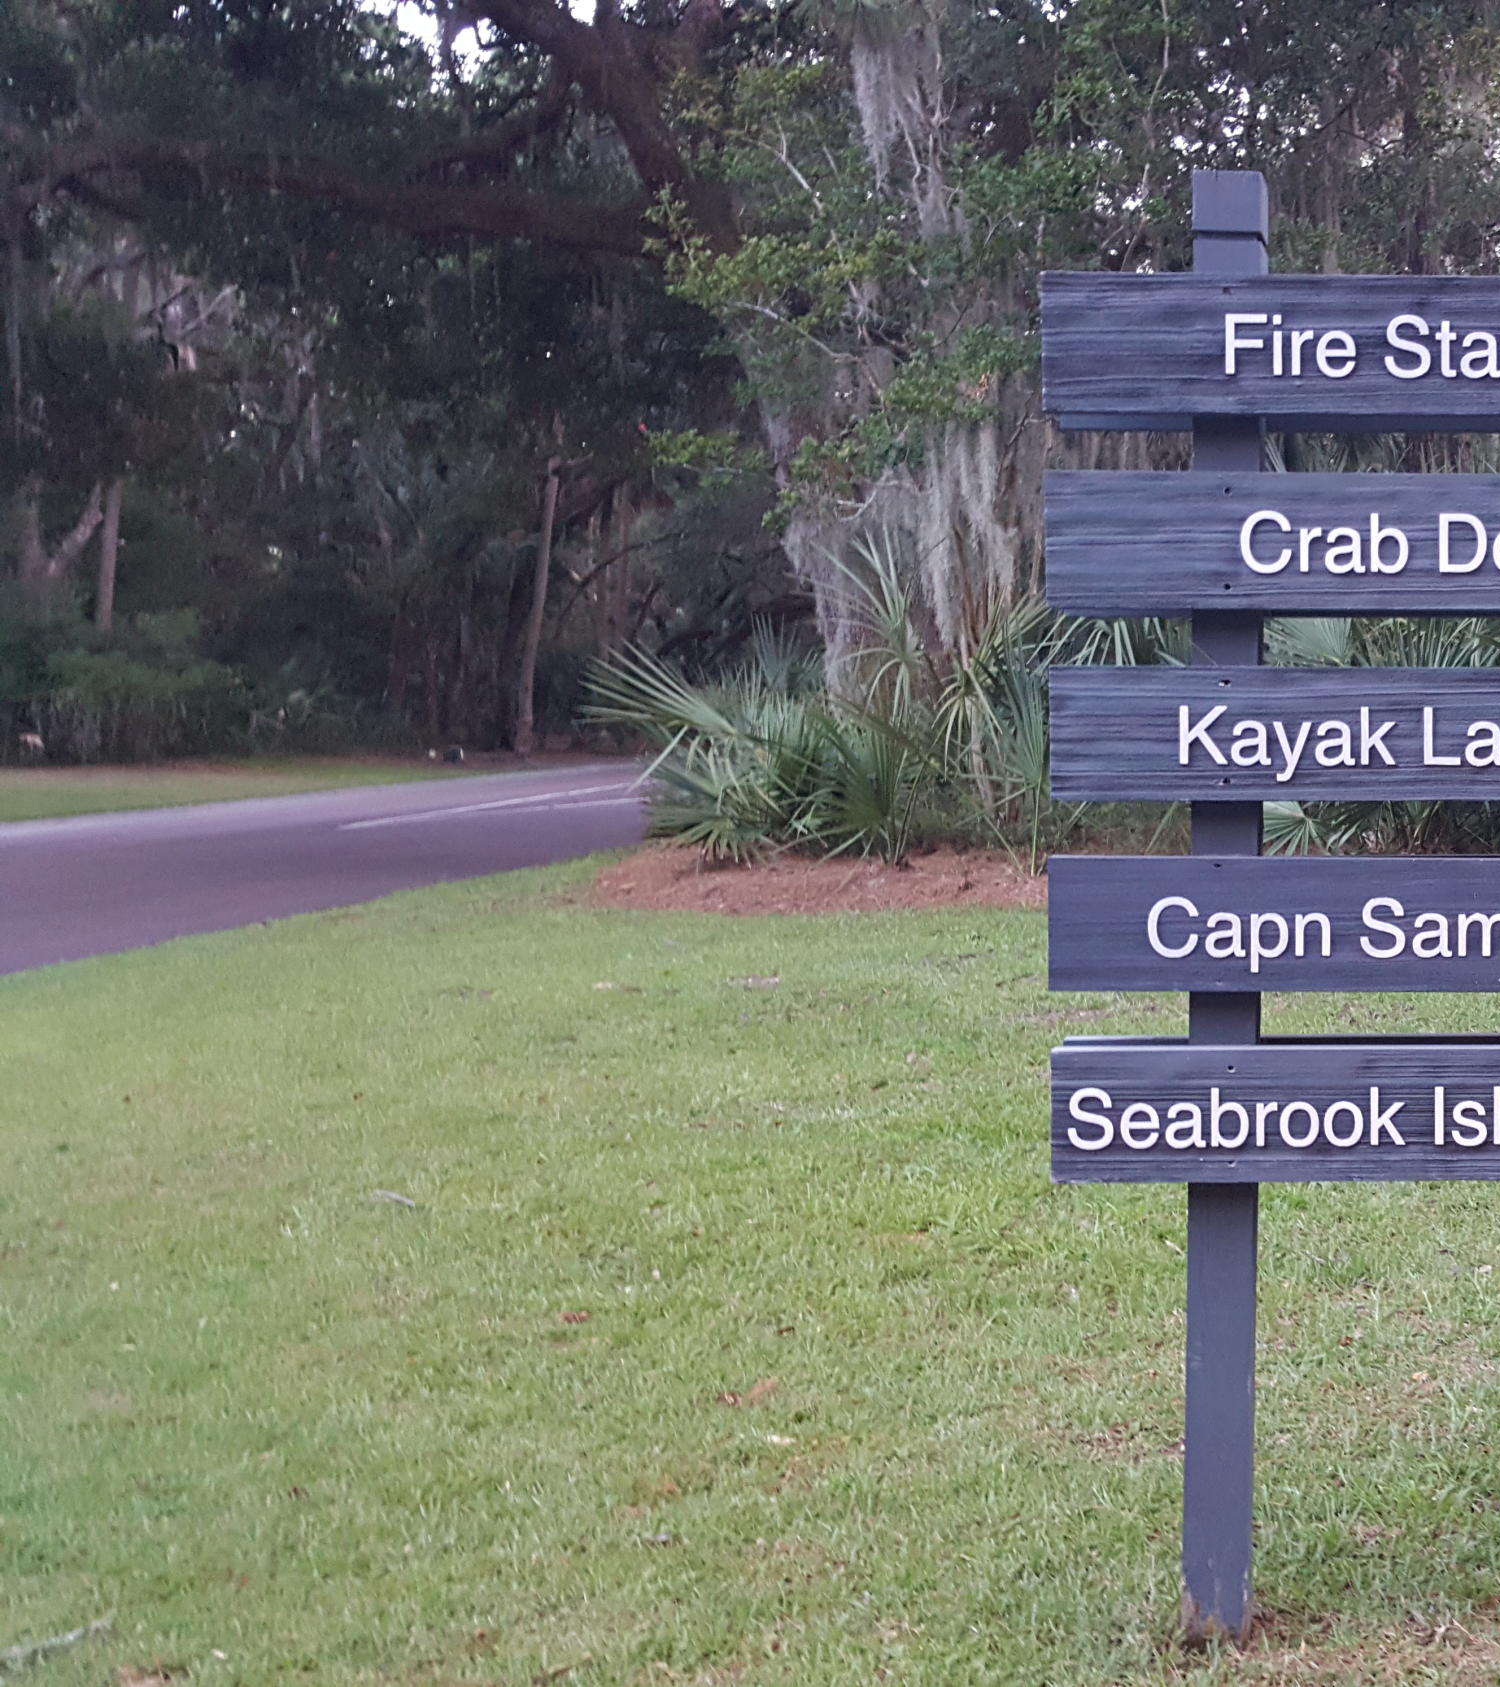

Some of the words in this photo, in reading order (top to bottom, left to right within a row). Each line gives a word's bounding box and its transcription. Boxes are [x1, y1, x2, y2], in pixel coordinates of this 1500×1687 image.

[1223, 312, 1357, 379] Fire
[1238, 508, 1410, 575] Crab
[1178, 703, 1397, 783] Kayak
[1146, 895, 1332, 974] Capn
[1066, 1085, 1407, 1151] Seabrook
